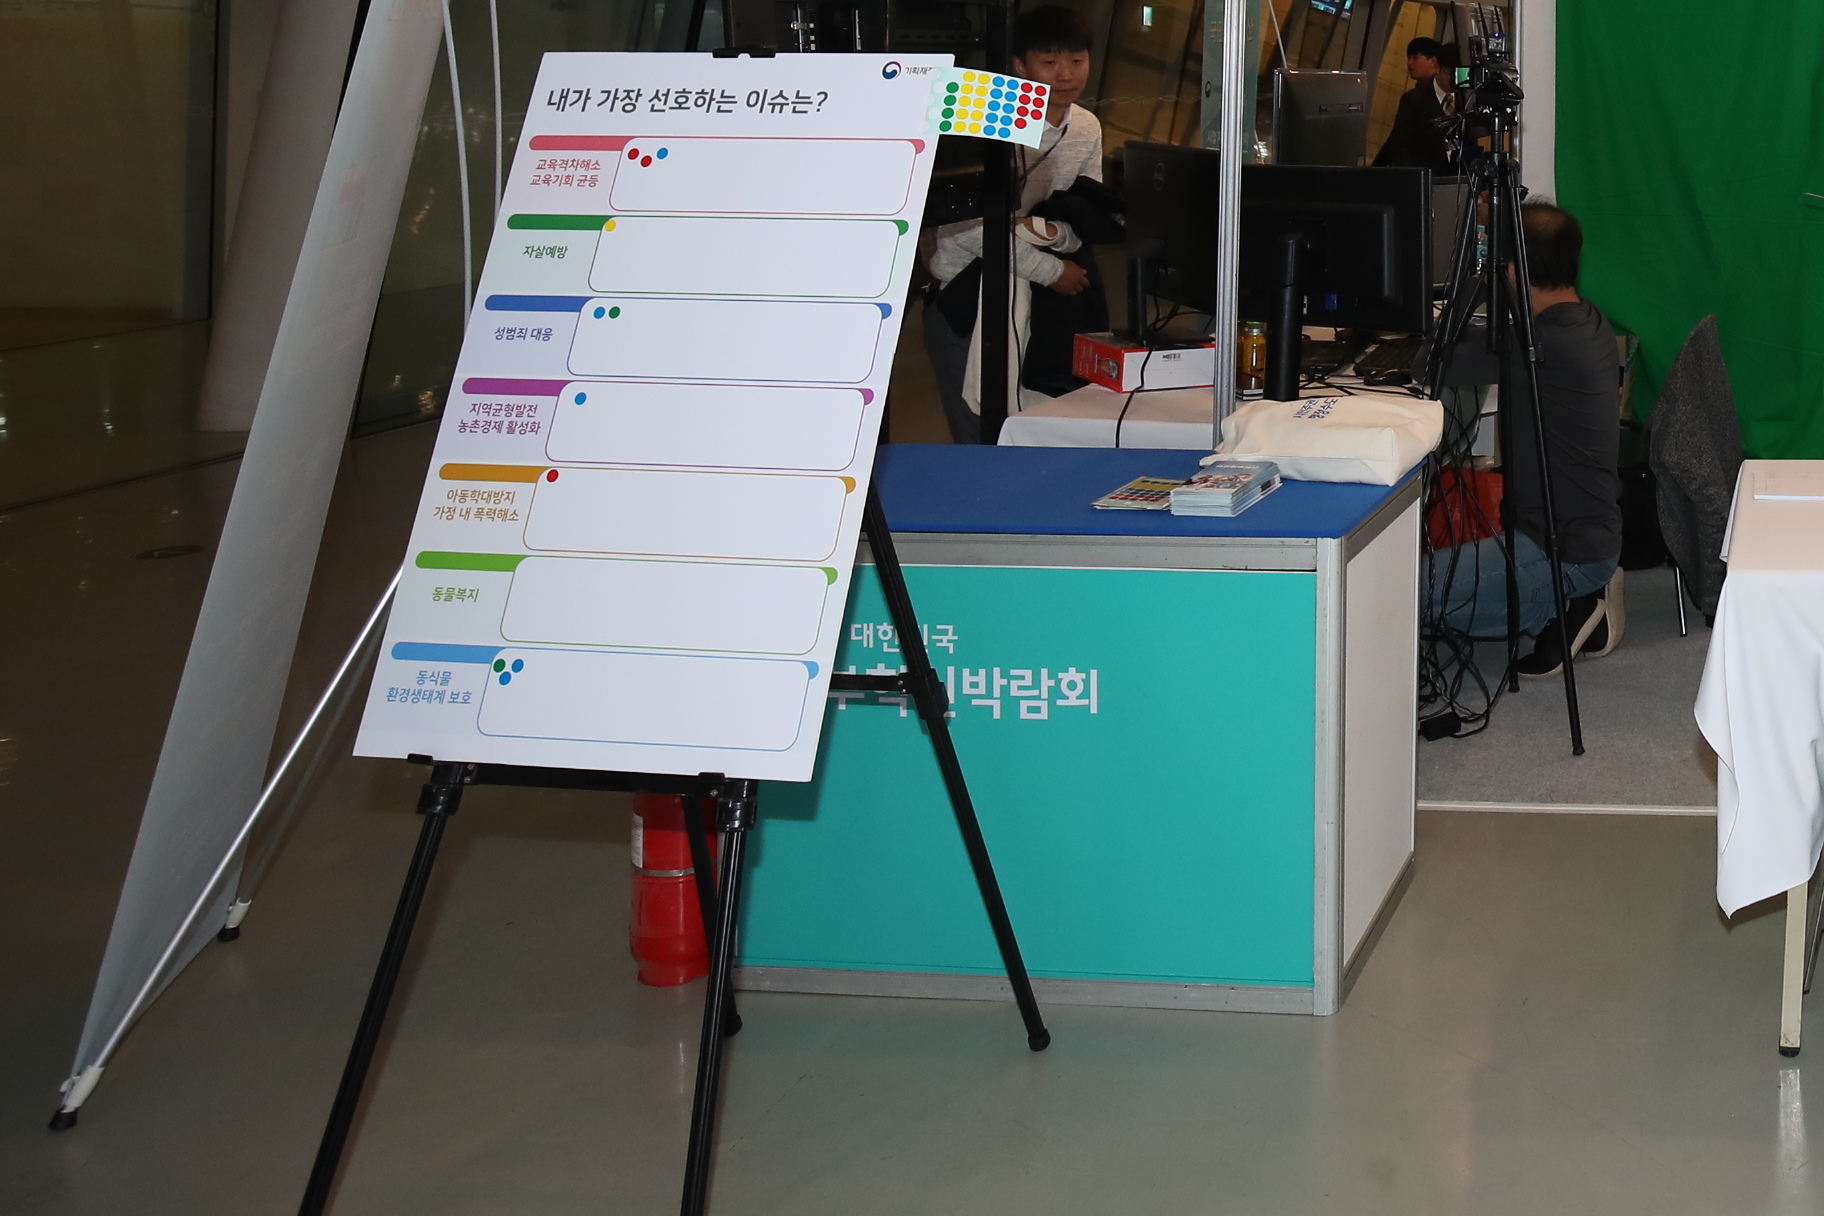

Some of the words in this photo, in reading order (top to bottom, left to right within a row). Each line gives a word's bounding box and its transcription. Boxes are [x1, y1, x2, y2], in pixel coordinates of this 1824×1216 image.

[546, 87, 591, 113] 내가
[597, 87, 642, 115] 가장
[648, 88, 738, 115] 선호하는
[745, 89, 829, 116] 이슈는?
[535, 158, 602, 173] 교육격차해소
[529, 173, 573, 188] 교육기회
[576, 173, 599, 188] 균등
[523, 244, 568, 260] 자살예방
[494, 325, 529, 342] 성범죄
[530, 326, 554, 342] 대응
[469, 402, 539, 419] 지역균형발전
[457, 419, 503, 435] 농촌경제
[507, 419, 541, 436] 활성화
[446, 489, 516, 507] 아동학대방지
[433, 506, 457, 522] 가정
[458, 506, 473, 522] 내
[474, 506, 520, 524] 폭력해소
[431, 586, 480, 604] 동물복지
[850, 622, 959, 654] 대한국
[415, 669, 453, 688] 동식물
[385, 687, 446, 705] 환경생태계
[447, 688, 473, 706] 보호
